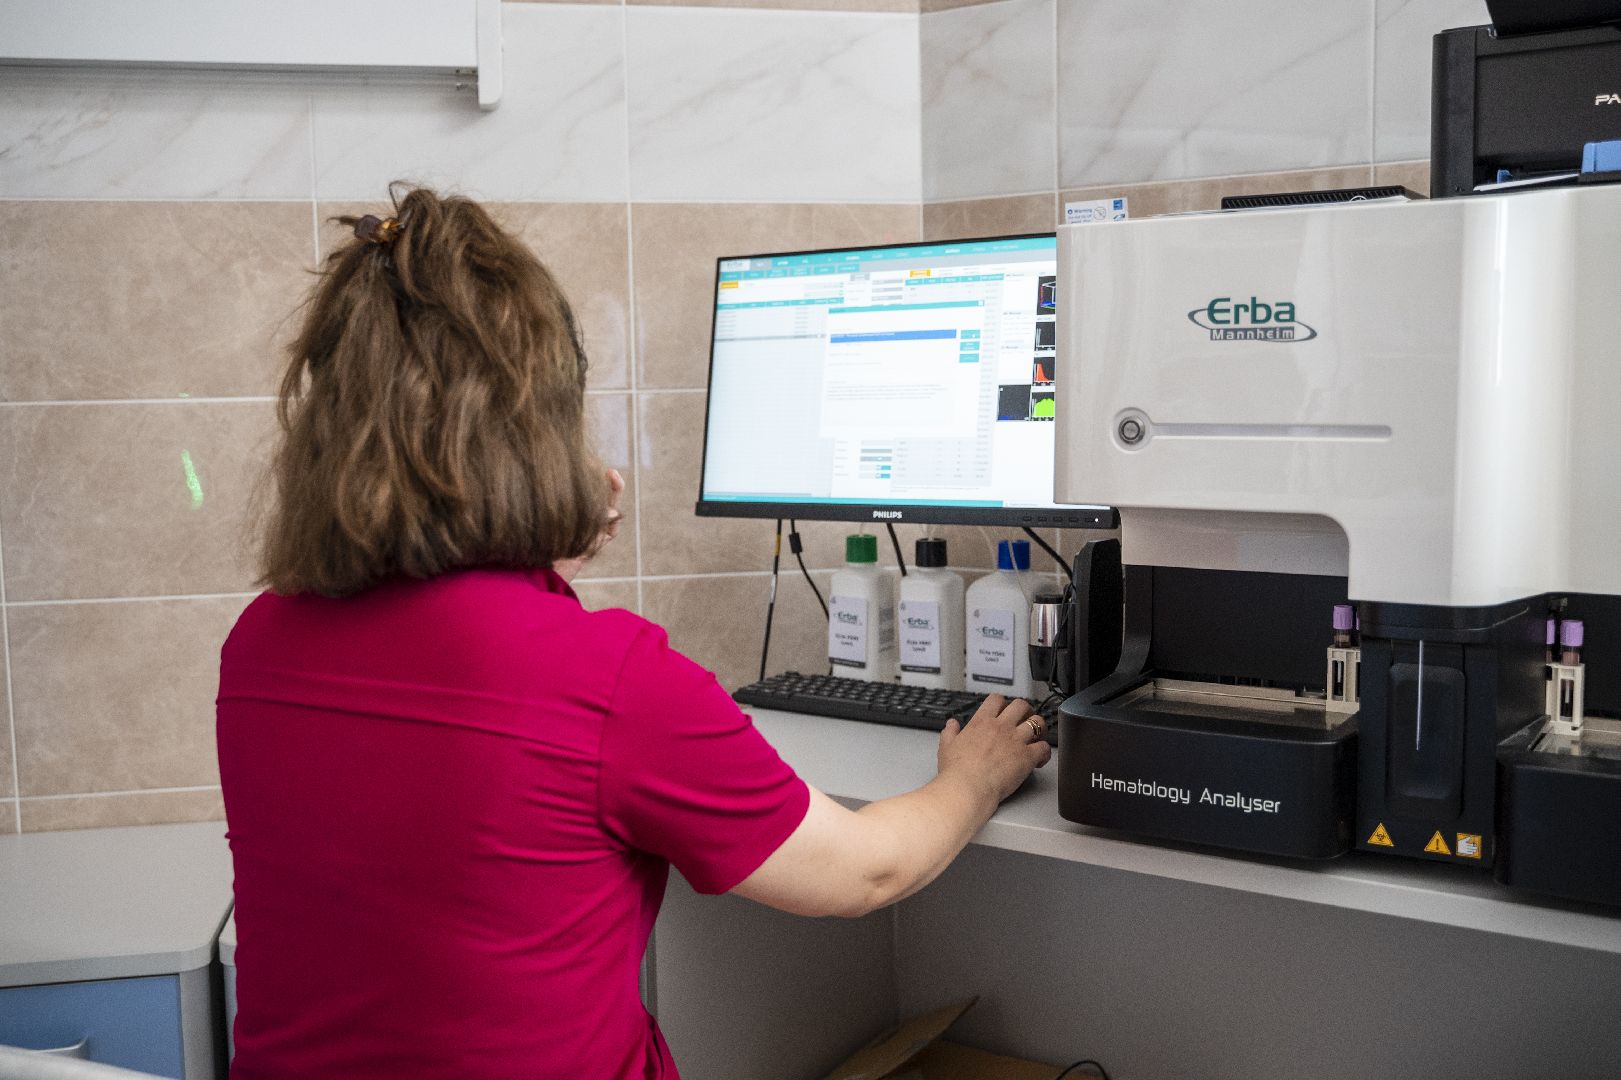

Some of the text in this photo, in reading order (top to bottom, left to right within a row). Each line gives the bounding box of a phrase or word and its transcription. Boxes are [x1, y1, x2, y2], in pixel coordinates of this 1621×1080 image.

[1207, 297, 1295, 324] Erba
[1211, 327, 1295, 340] Mannheim
[872, 510, 902, 519] PHILIPS
[907, 617, 929, 626] Erba
[982, 626, 1004, 636] Erba
[1091, 772, 1281, 813] Hematology Analyser
